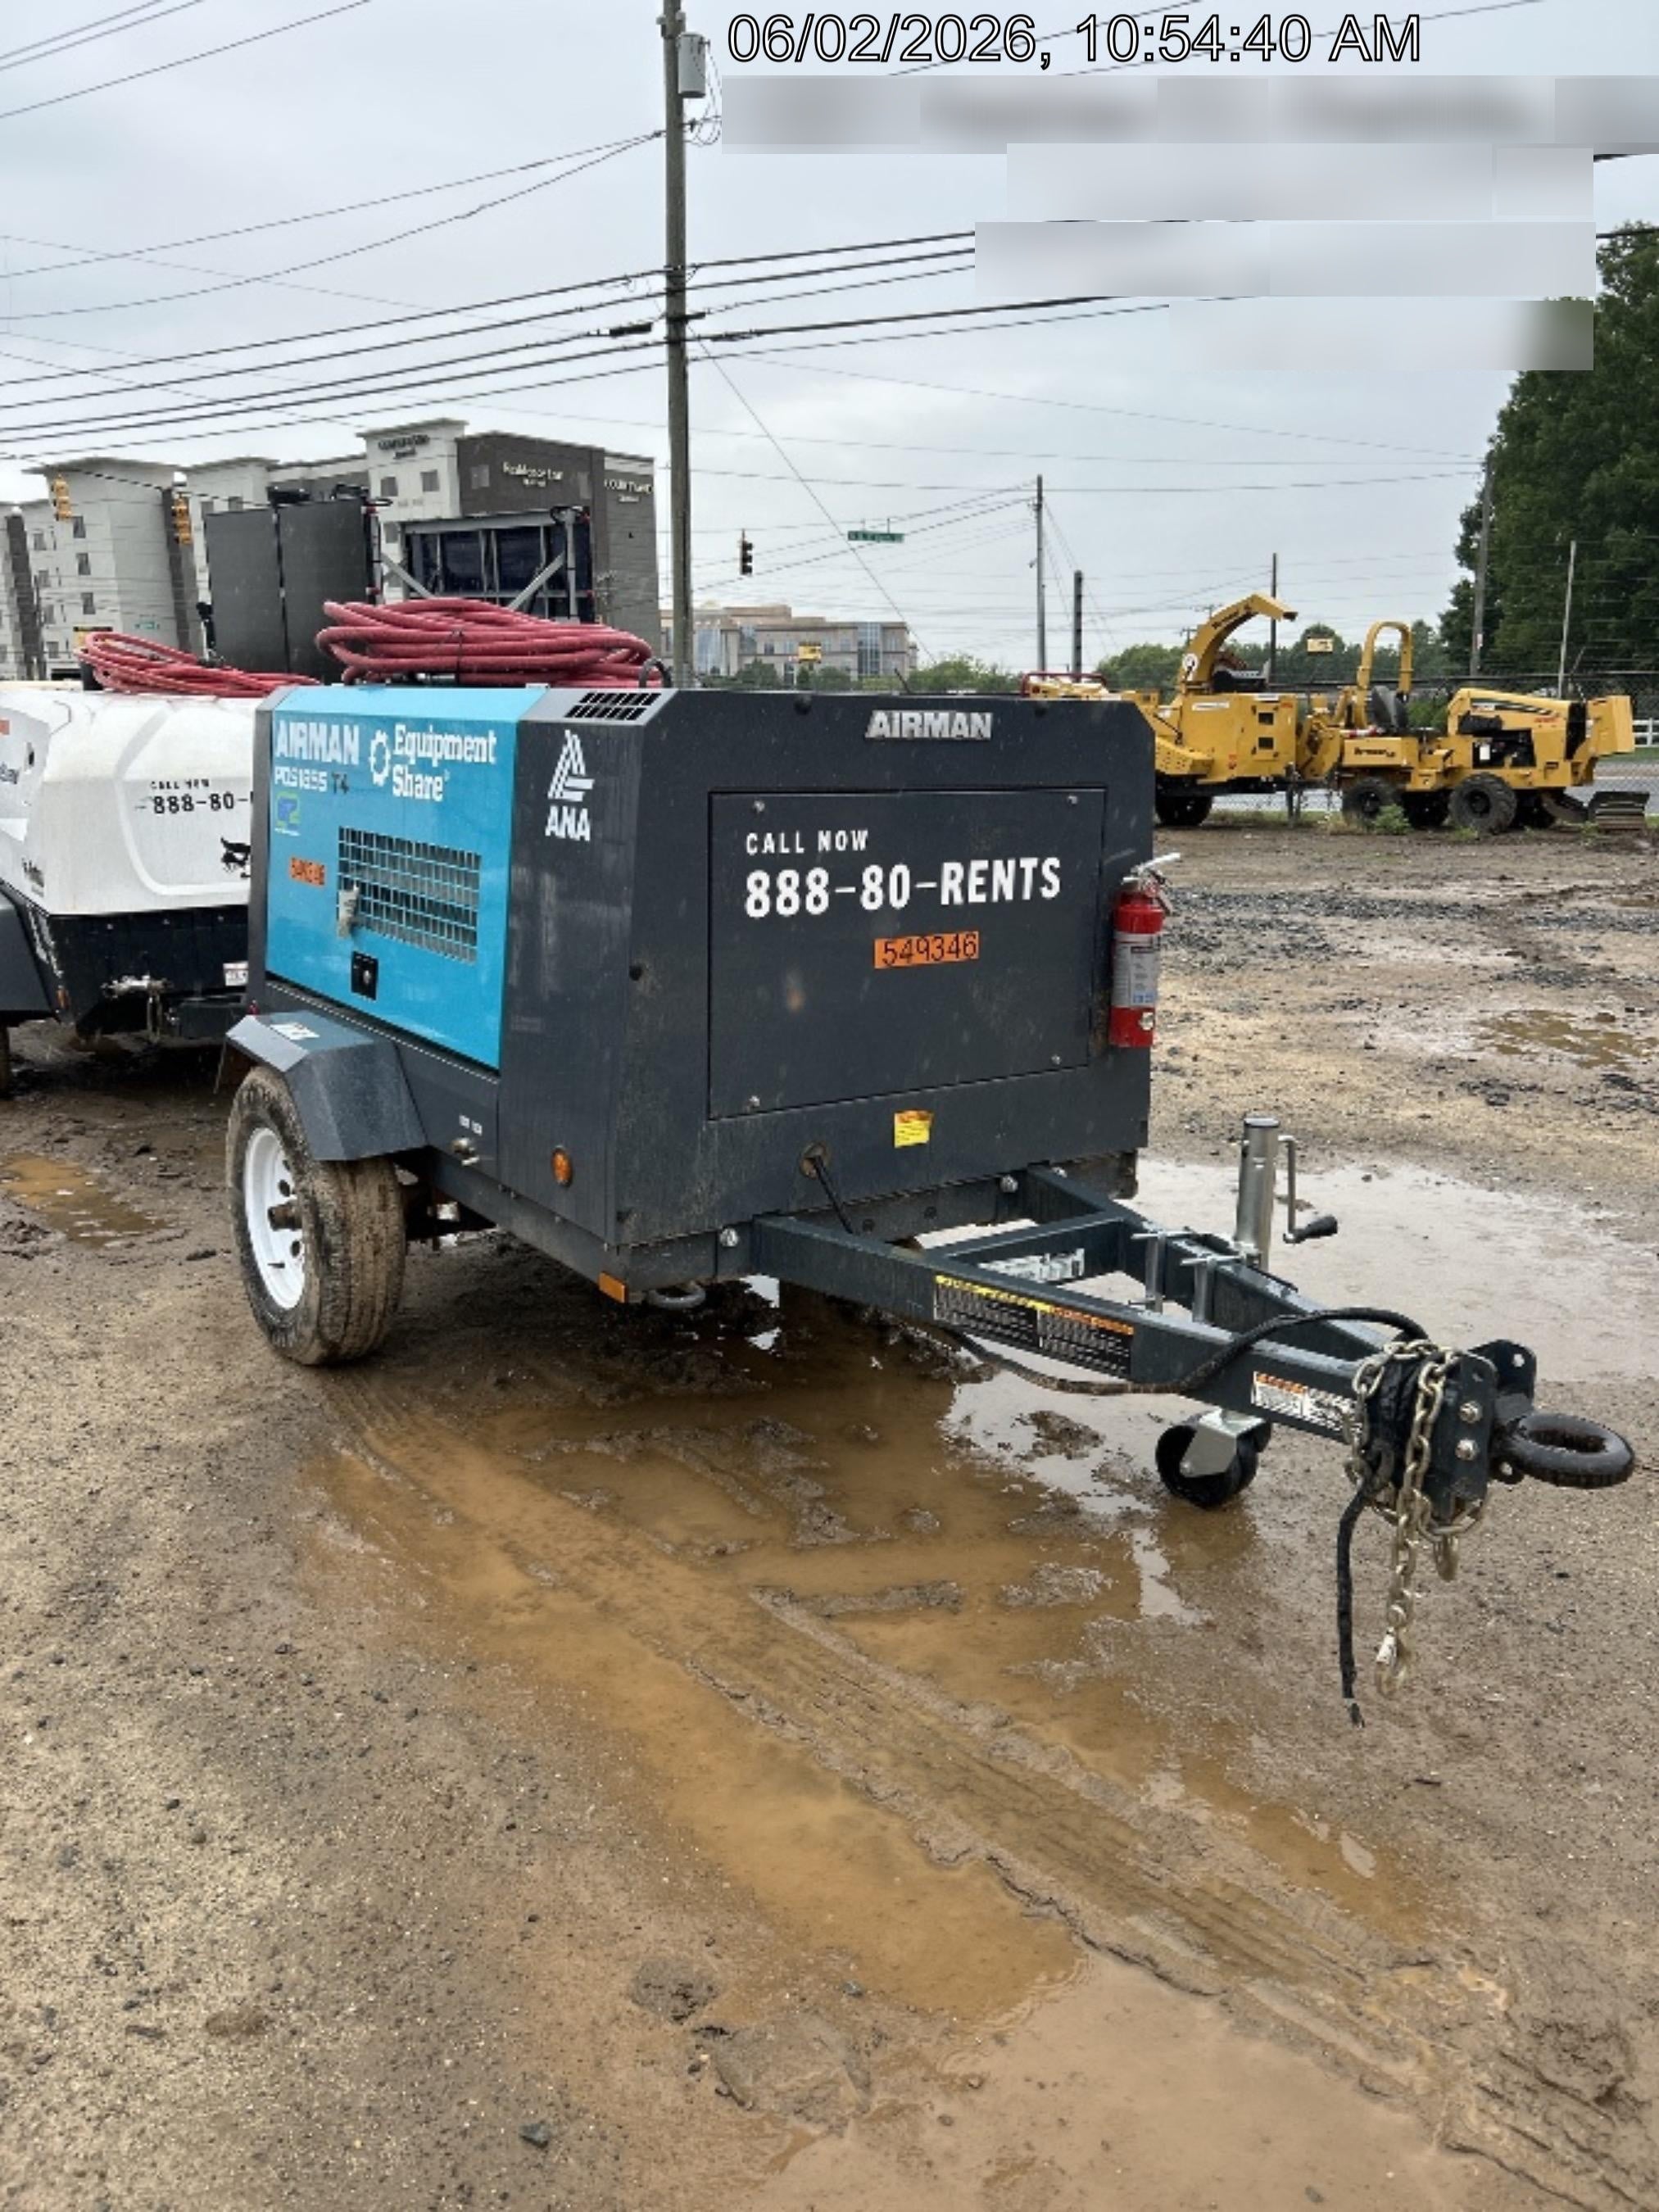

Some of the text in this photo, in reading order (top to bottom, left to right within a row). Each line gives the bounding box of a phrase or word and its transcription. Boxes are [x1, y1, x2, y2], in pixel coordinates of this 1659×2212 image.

[275, 720, 359, 765] AIRMAN
[864, 709, 993, 740] AIRMAN
[393, 723, 496, 767] Equipment
[392, 764, 444, 801] Share
[153, 790, 253, 814] 888-80-
[545, 805, 590, 841] ANA
[746, 829, 868, 855] CALL NOW
[746, 857, 1060, 918] 888-80-RENTS
[882, 933, 977, 968] 549346
